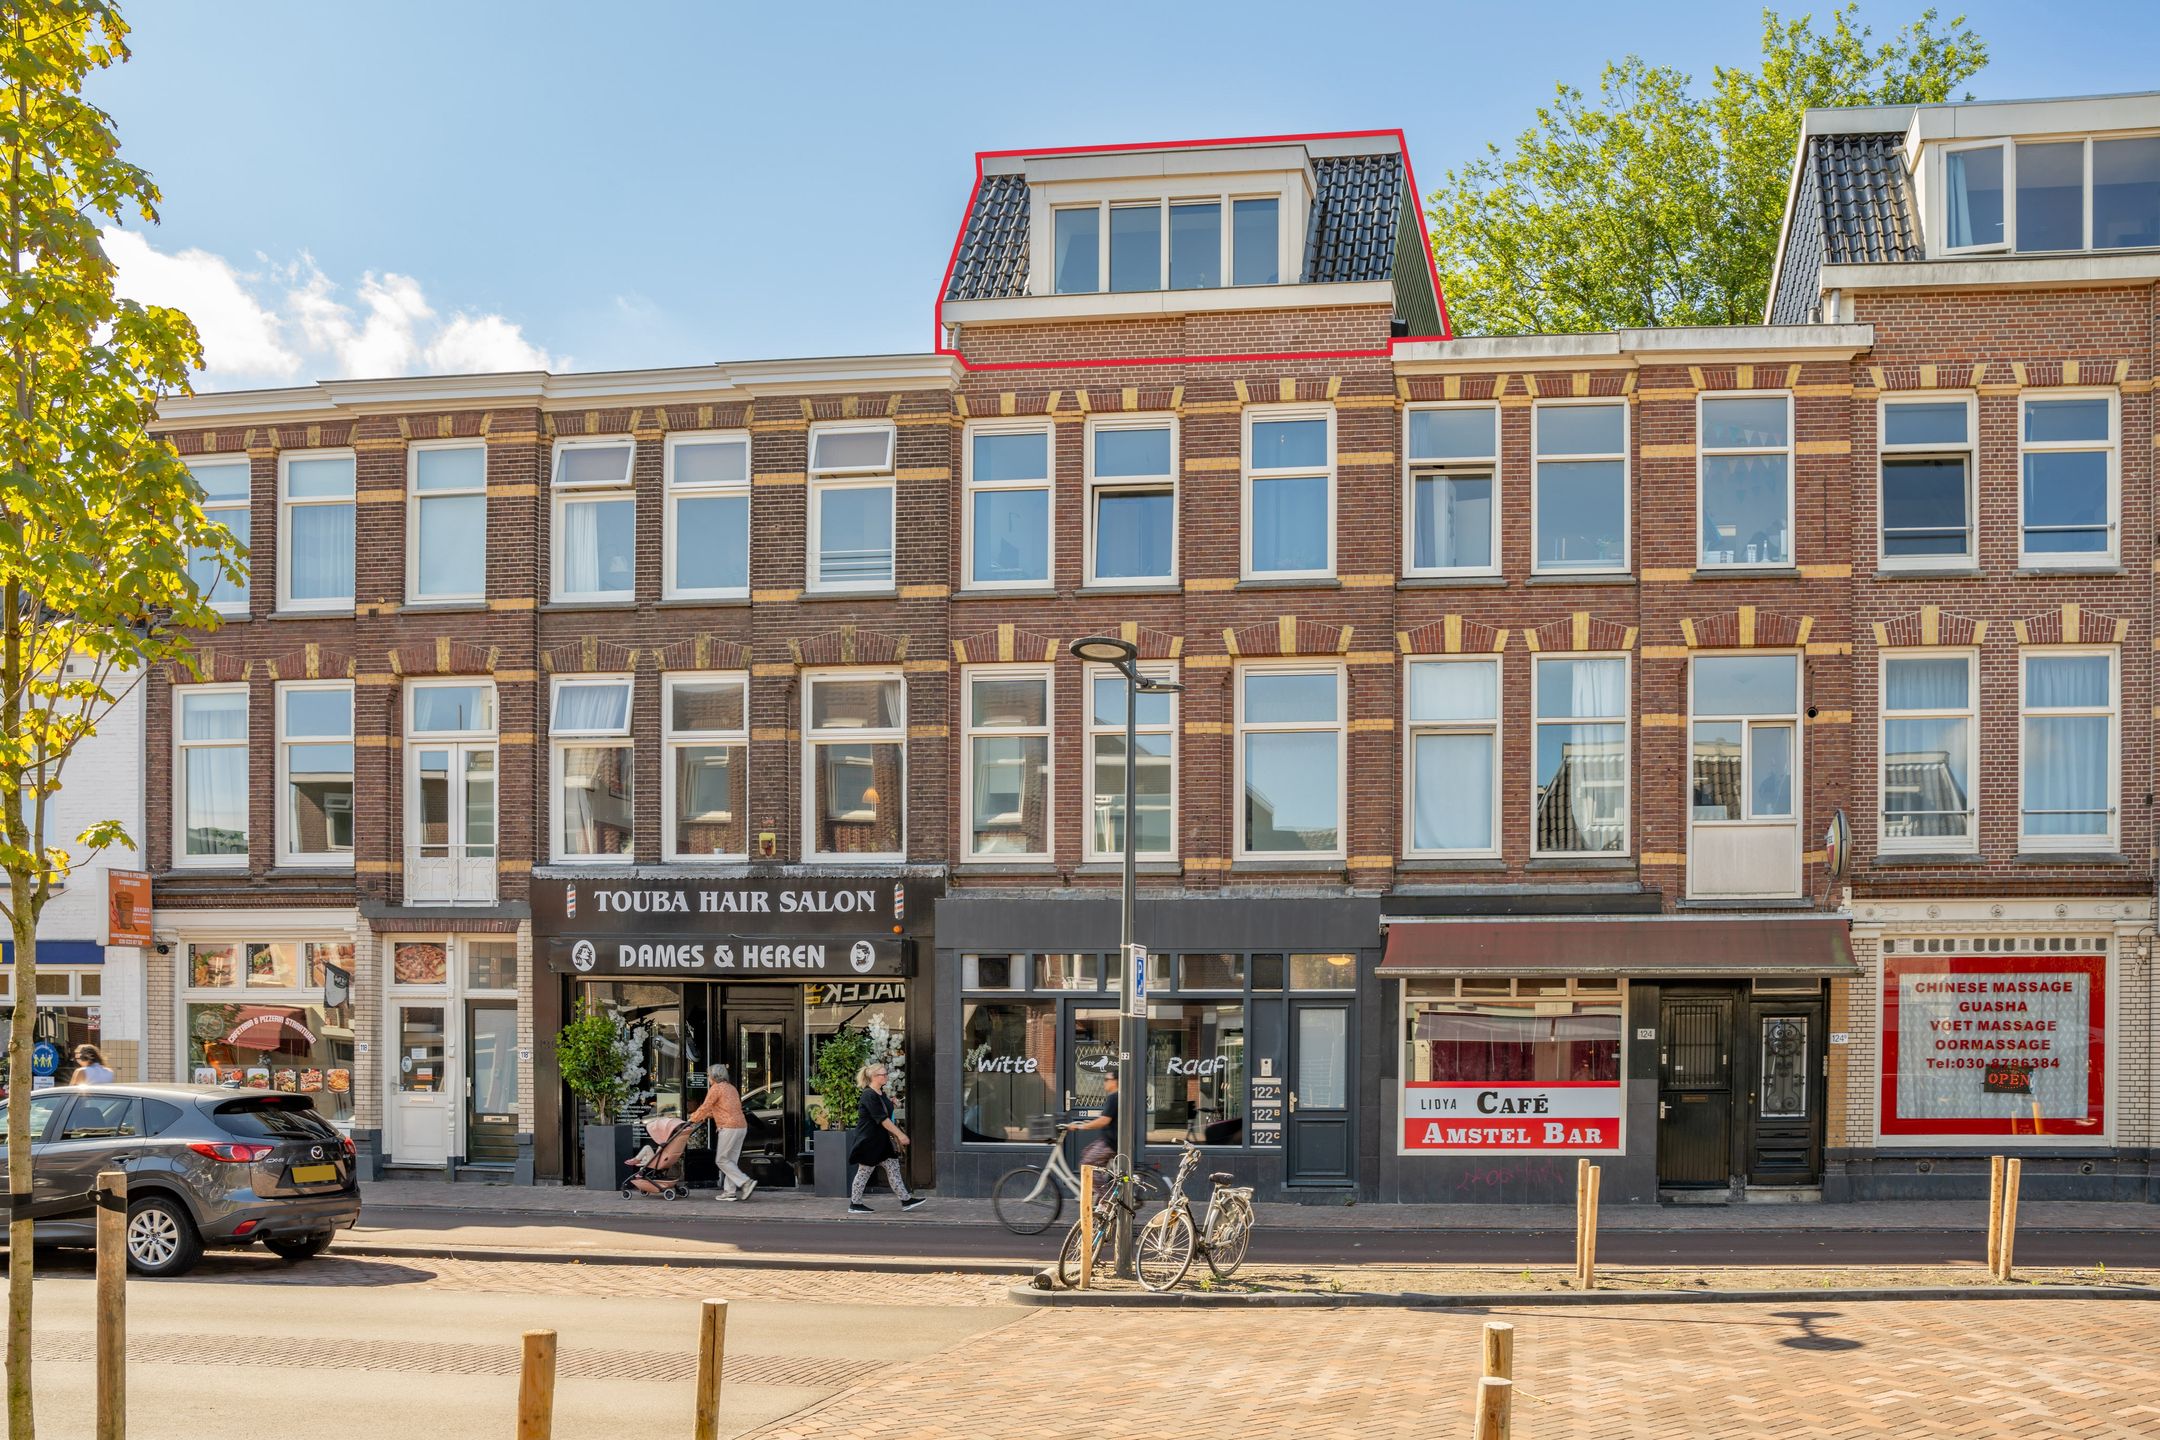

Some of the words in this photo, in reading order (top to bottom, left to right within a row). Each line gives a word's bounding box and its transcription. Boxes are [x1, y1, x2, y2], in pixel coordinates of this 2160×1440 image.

[594, 890, 690, 912] TOUBA
[698, 890, 772, 912] HAIR
[779, 890, 876, 912] SALON
[618, 944, 705, 968] DAMES
[713, 944, 736, 968] &
[742, 944, 825, 968] HEREN
[1915, 982, 1987, 993] CHINESE
[1993, 982, 2073, 993] MASSAGE
[1959, 1002, 2028, 1012] GUASHA
[1930, 1020, 1973, 1031] VOET
[1978, 1020, 2057, 1031] MASSAGE
[1935, 1039, 2051, 1050] OORMASSAGE
[1166, 1055, 1228, 1075] Raaf
[1988, 1072, 2030, 1086] OPEN
[1420, 1098, 1457, 1110] LIDYA
[1422, 1122, 1531, 1144] AMSTEL
[1543, 1122, 1603, 1144] BAR
